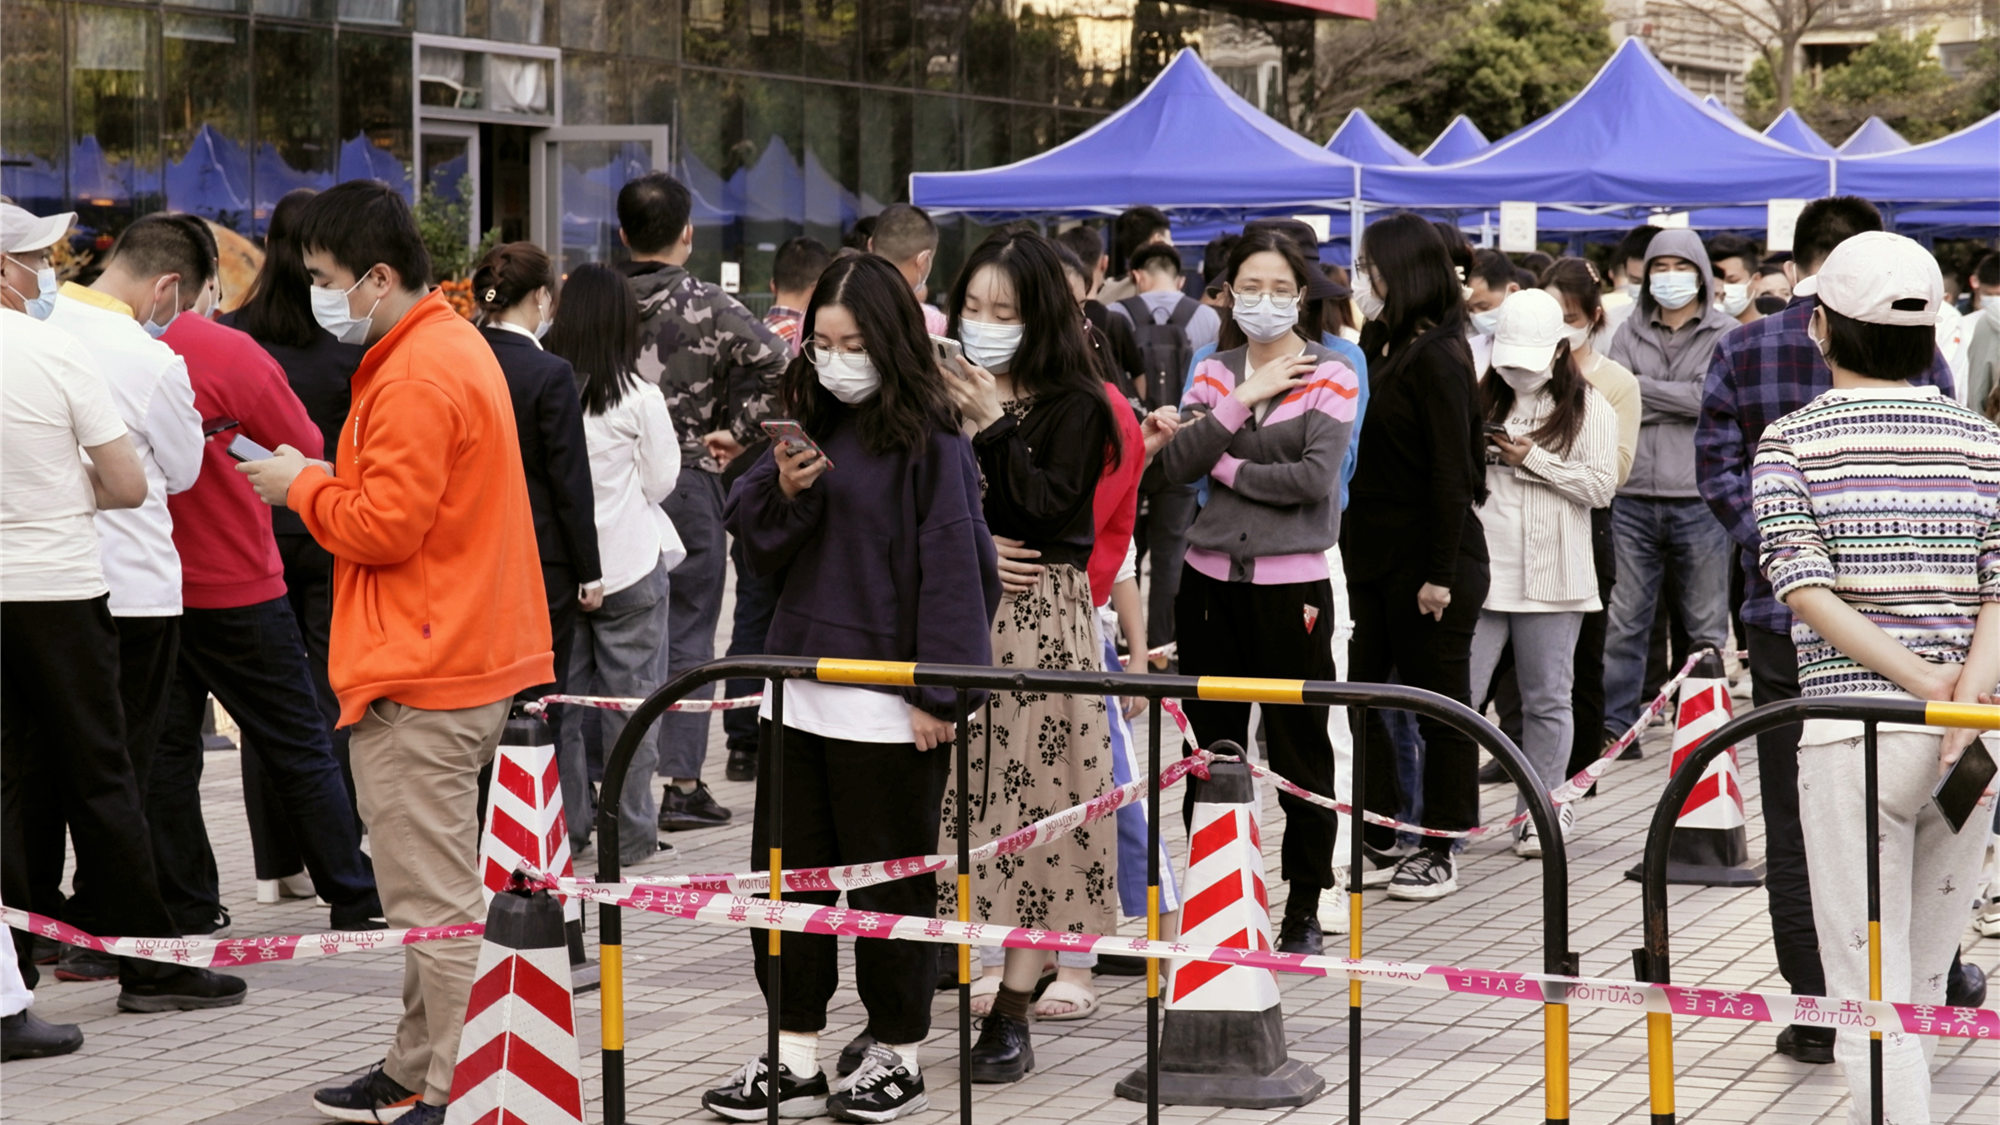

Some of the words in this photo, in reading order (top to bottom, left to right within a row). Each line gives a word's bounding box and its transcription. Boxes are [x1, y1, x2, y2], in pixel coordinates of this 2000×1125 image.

[1045, 812, 1079, 832] CAUTION
[644, 889, 700, 903] SAFE
[727, 906, 785, 924] 注意
[824, 911, 880, 932] 安全
[320, 931, 384, 943] CAUTION
[923, 920, 984, 939] 注意
[135, 939, 200, 950] CAUTION
[233, 935, 288, 946] SAFE
[227, 945, 279, 961] 安全
